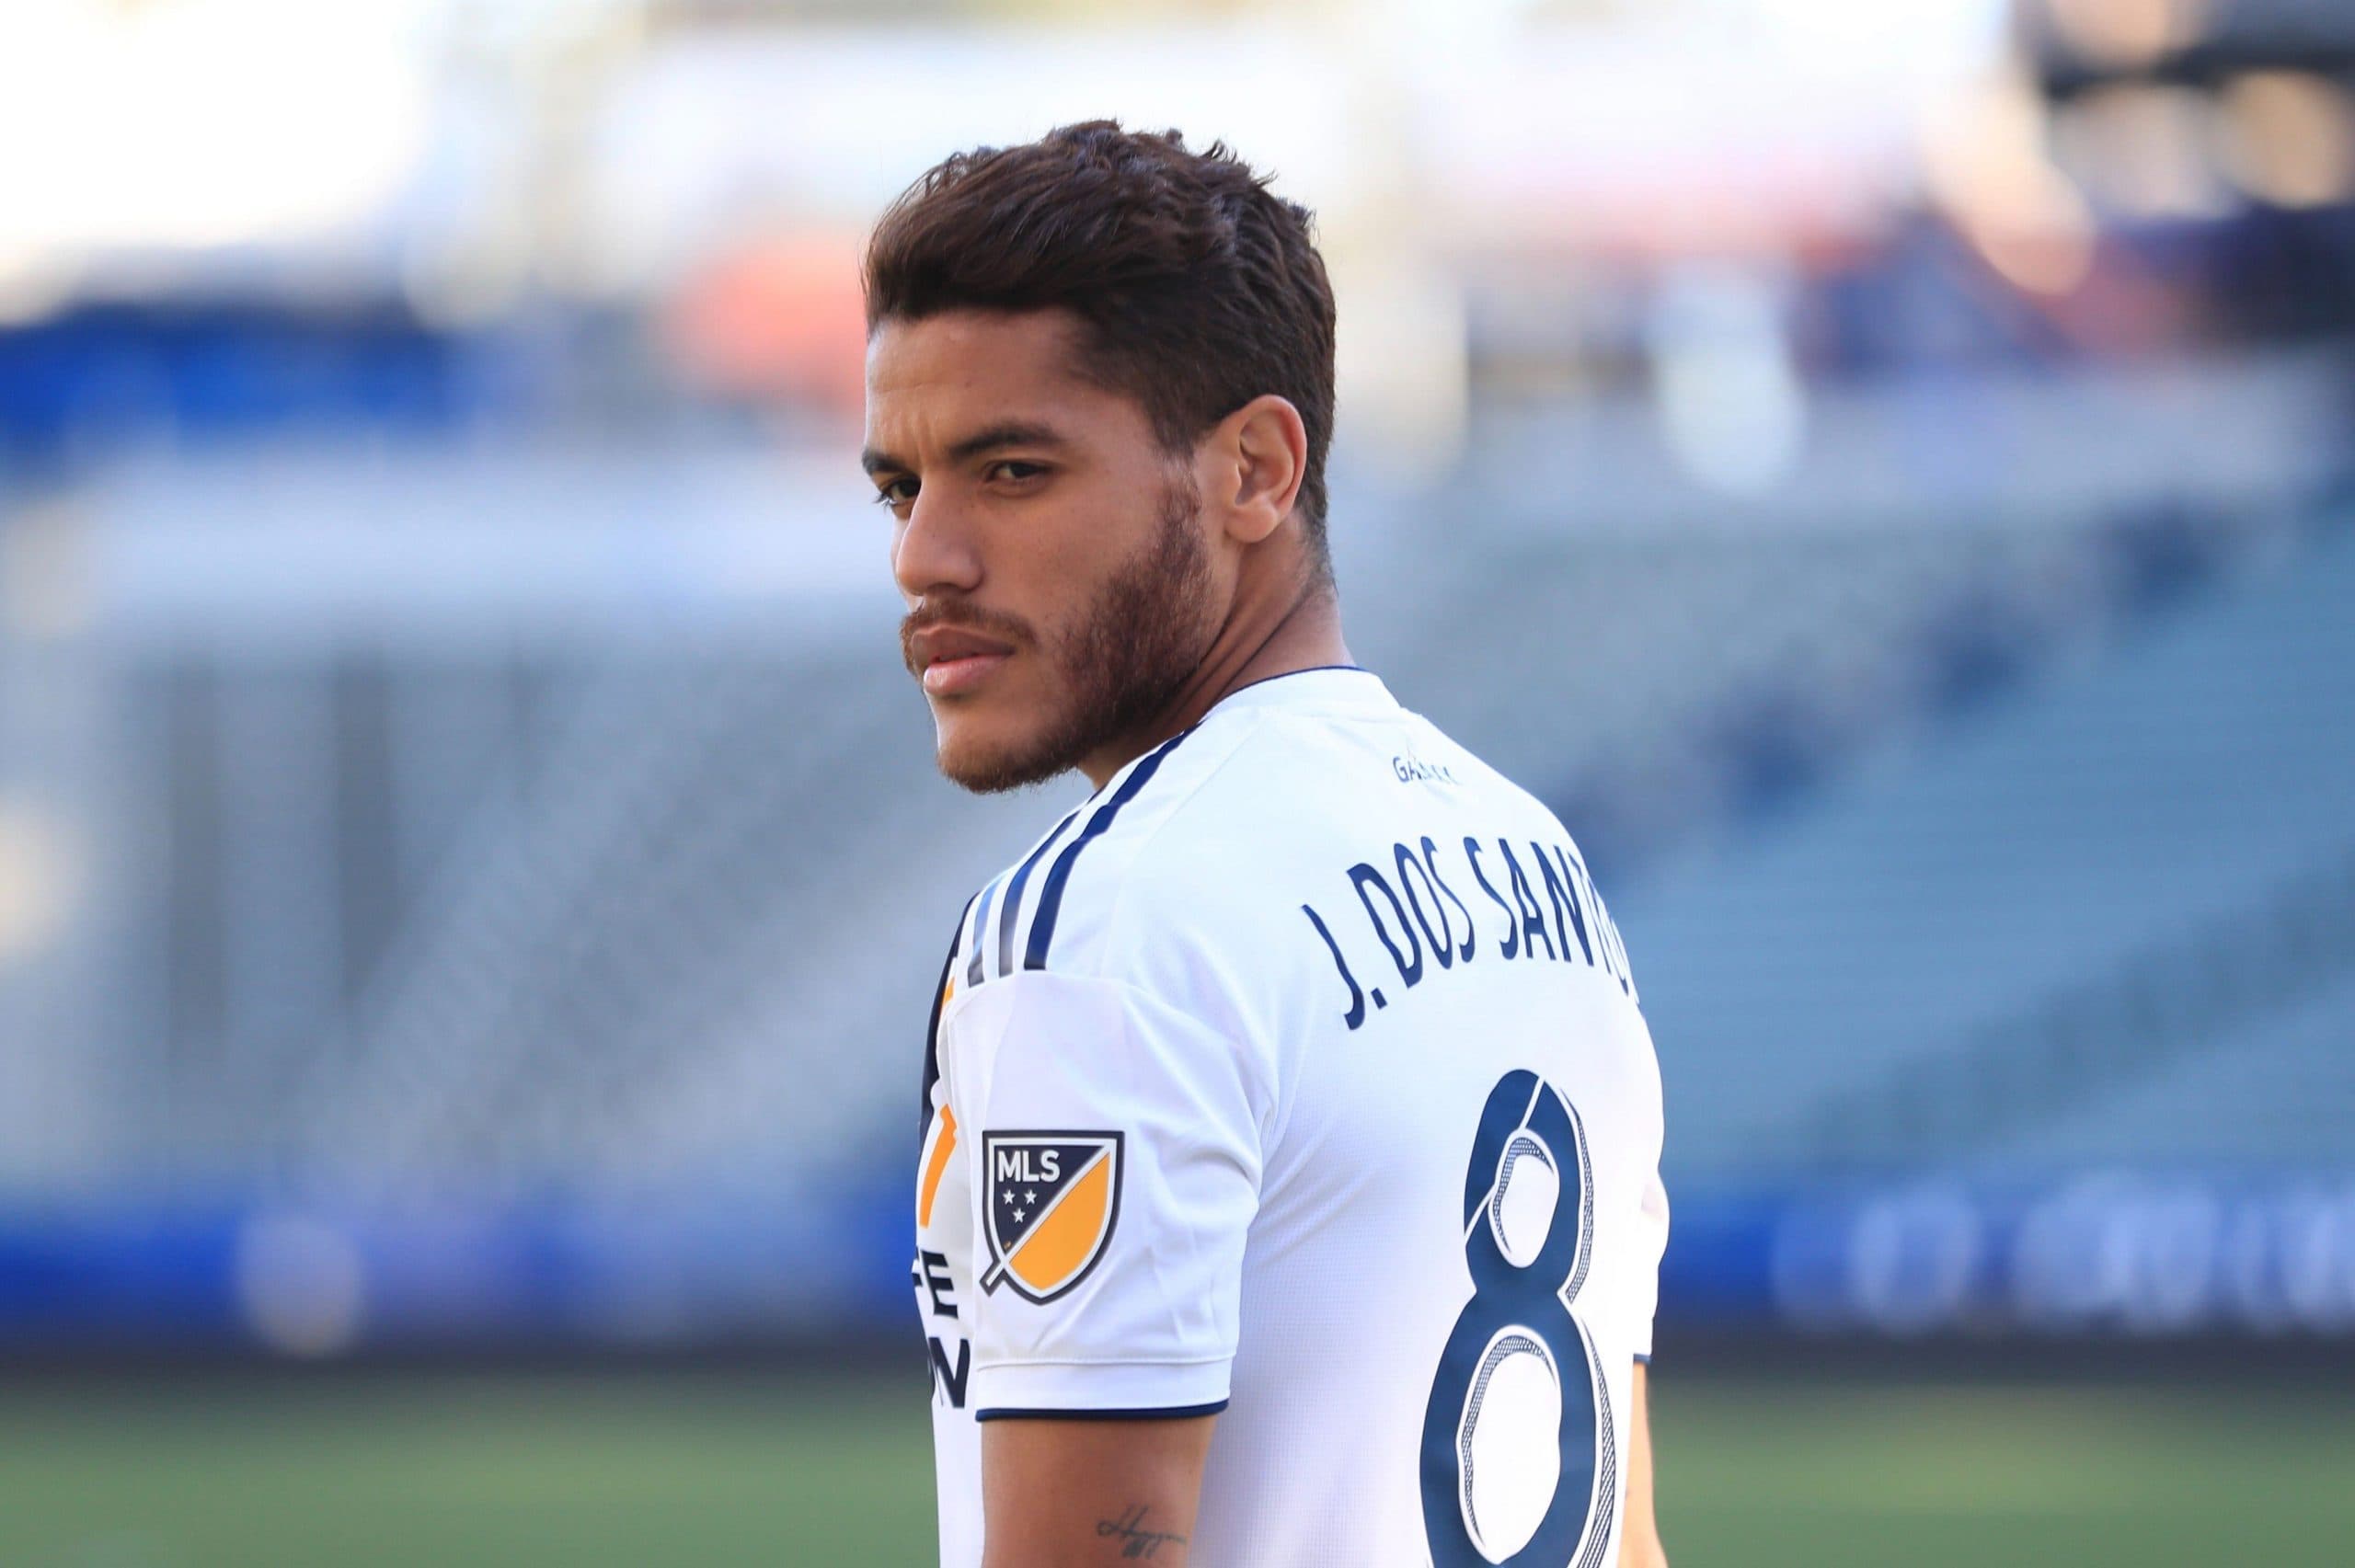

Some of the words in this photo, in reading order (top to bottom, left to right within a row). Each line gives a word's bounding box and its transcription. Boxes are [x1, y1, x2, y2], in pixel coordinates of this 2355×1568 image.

[1301, 904, 1388, 1031] J.
[1347, 836, 1476, 989] DOS
[997, 1150, 1061, 1183] MLS
[1419, 1069, 1616, 1568] 8
